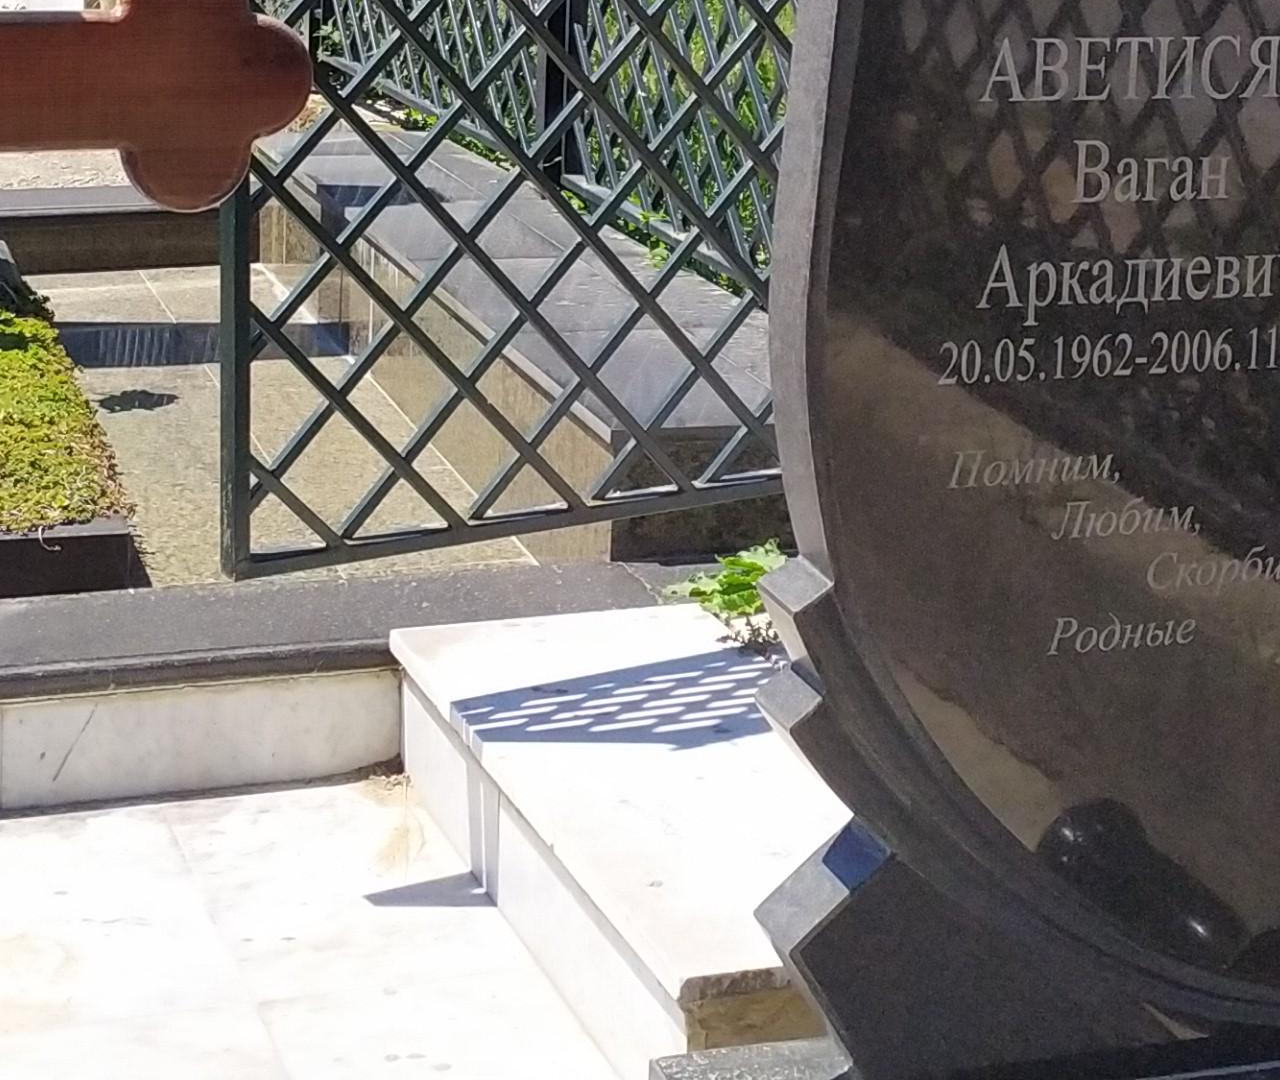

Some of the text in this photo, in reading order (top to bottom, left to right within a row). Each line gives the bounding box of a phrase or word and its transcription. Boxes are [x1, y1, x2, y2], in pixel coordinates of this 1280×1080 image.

[1072, 139, 1232, 204] Ваган
[948, 450, 1121, 491] Помним,
[1051, 496, 1202, 541] Любим,
[1046, 612, 1198, 657] Родные
